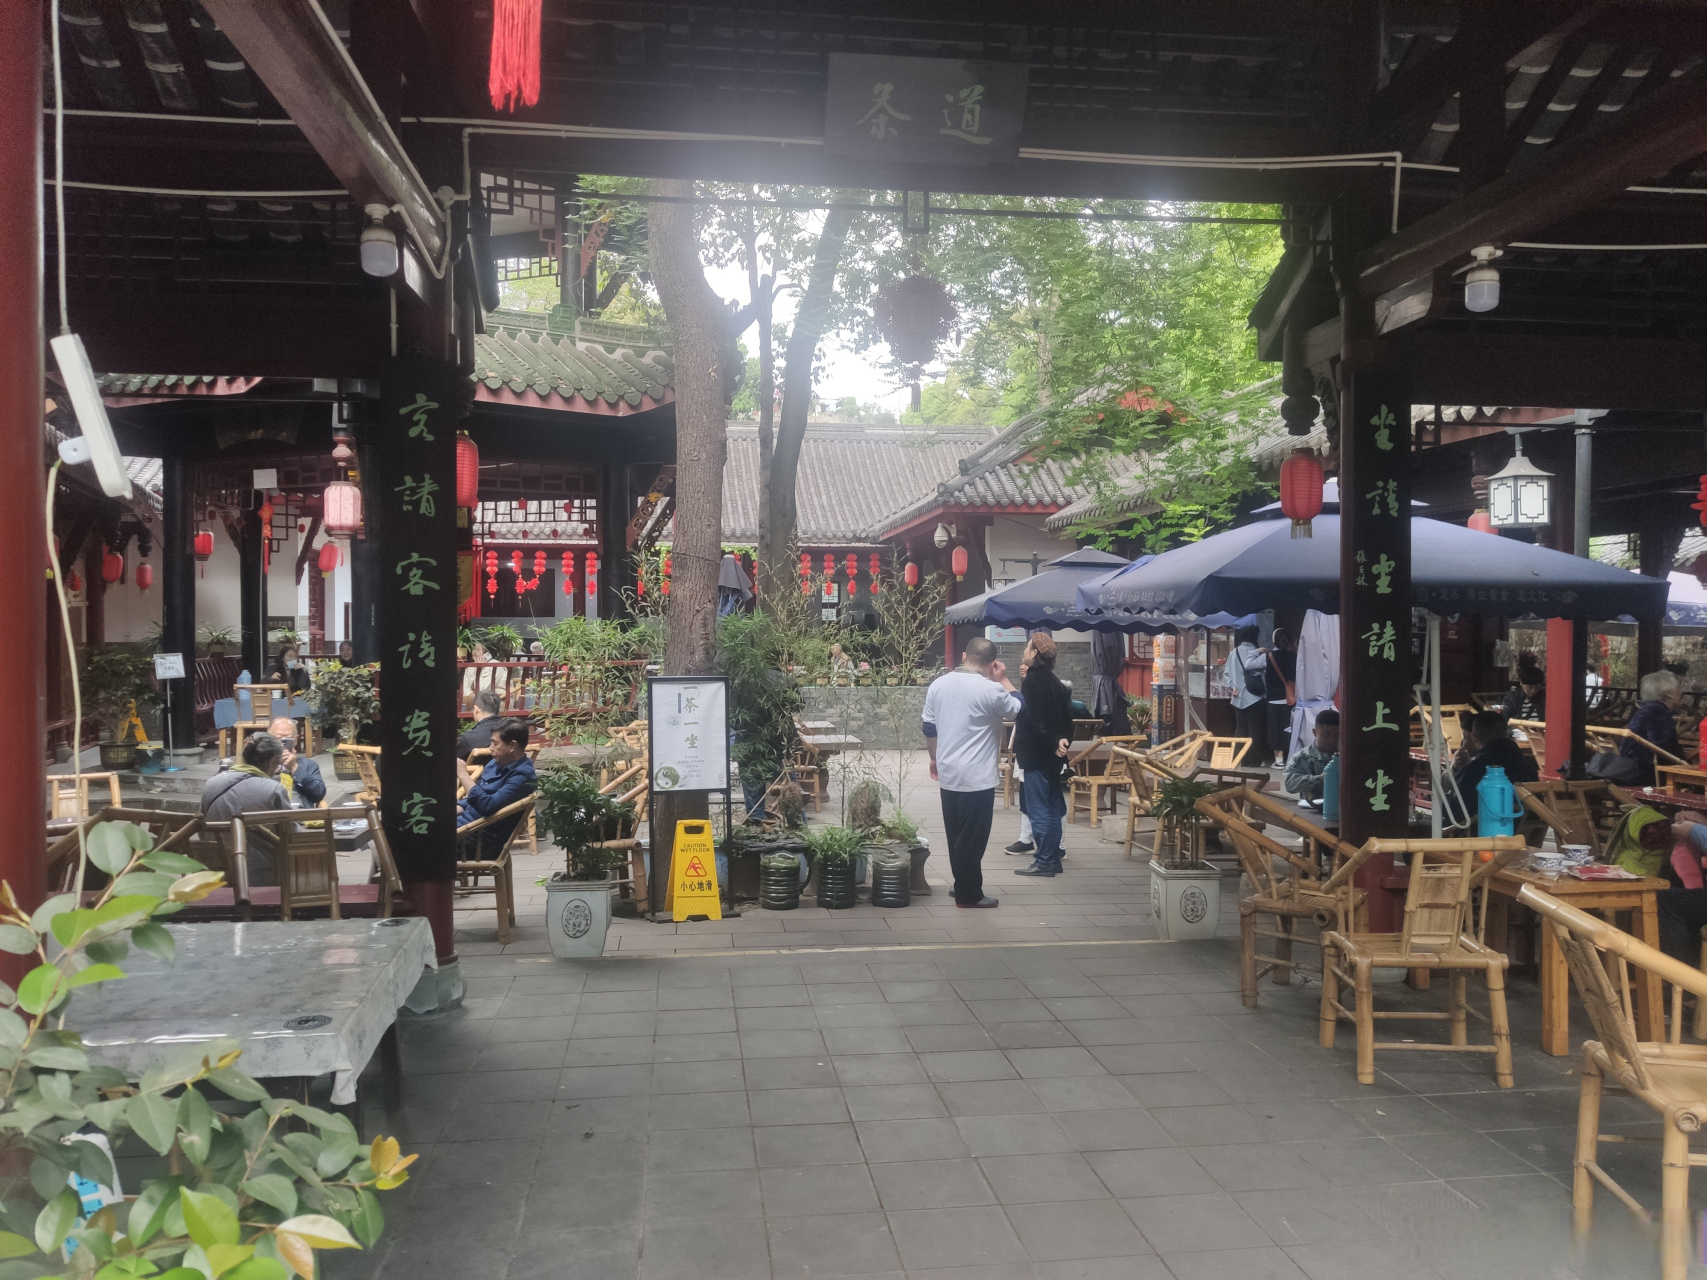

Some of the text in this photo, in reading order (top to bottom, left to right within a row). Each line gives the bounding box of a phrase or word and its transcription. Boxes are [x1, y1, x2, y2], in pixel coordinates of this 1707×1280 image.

[683, 685, 699, 749] 一茶一坐
[680, 880, 713, 892] 小心地滑
